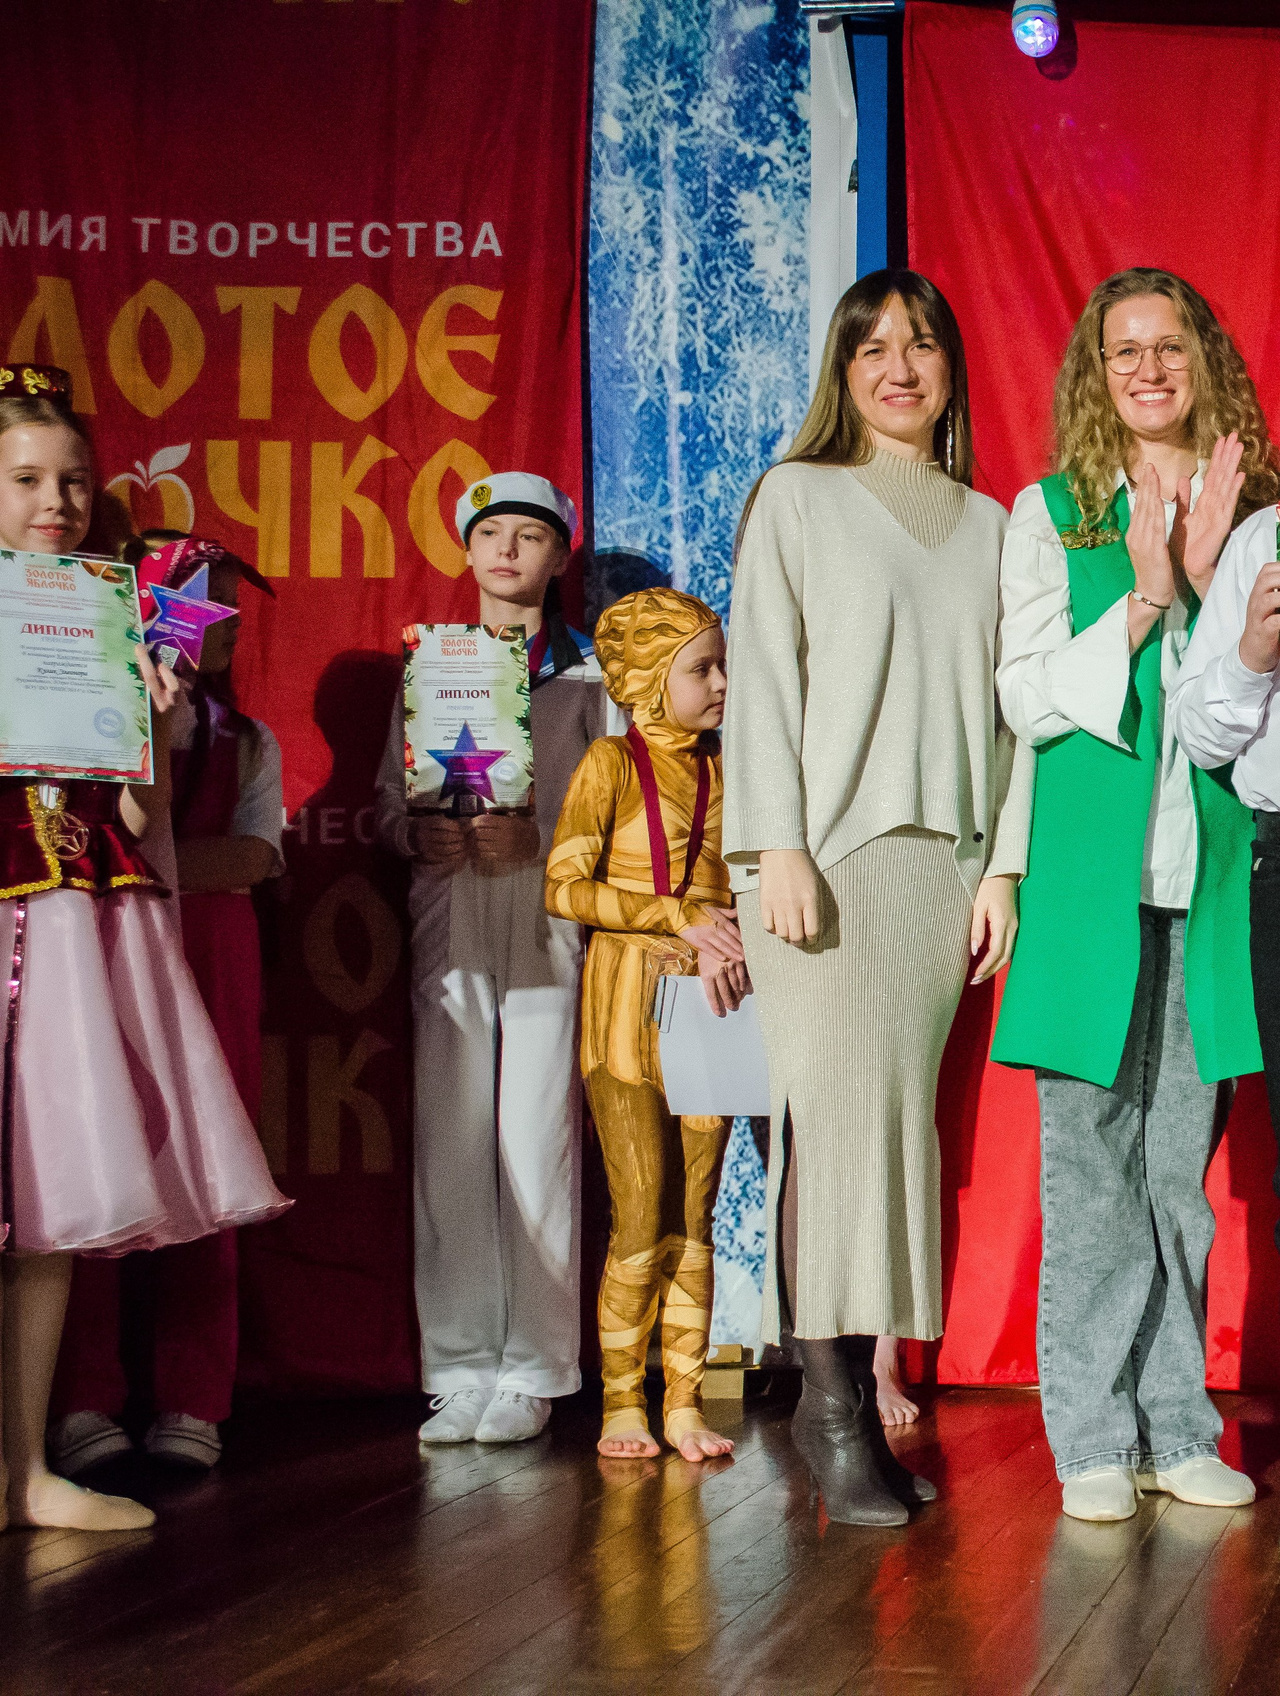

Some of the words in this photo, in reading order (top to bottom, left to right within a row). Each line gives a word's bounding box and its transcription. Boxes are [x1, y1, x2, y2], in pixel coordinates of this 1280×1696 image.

[132, 216, 504, 259] ТВОРЧЕСТВА
[24, 568, 75, 582] ЗОЛОТОЕ
[26, 578, 77, 591] ЯБЛОЧКО
[20, 623, 95, 639] ДИПЛОМ
[435, 689, 490, 700] ДИПЛОМ
